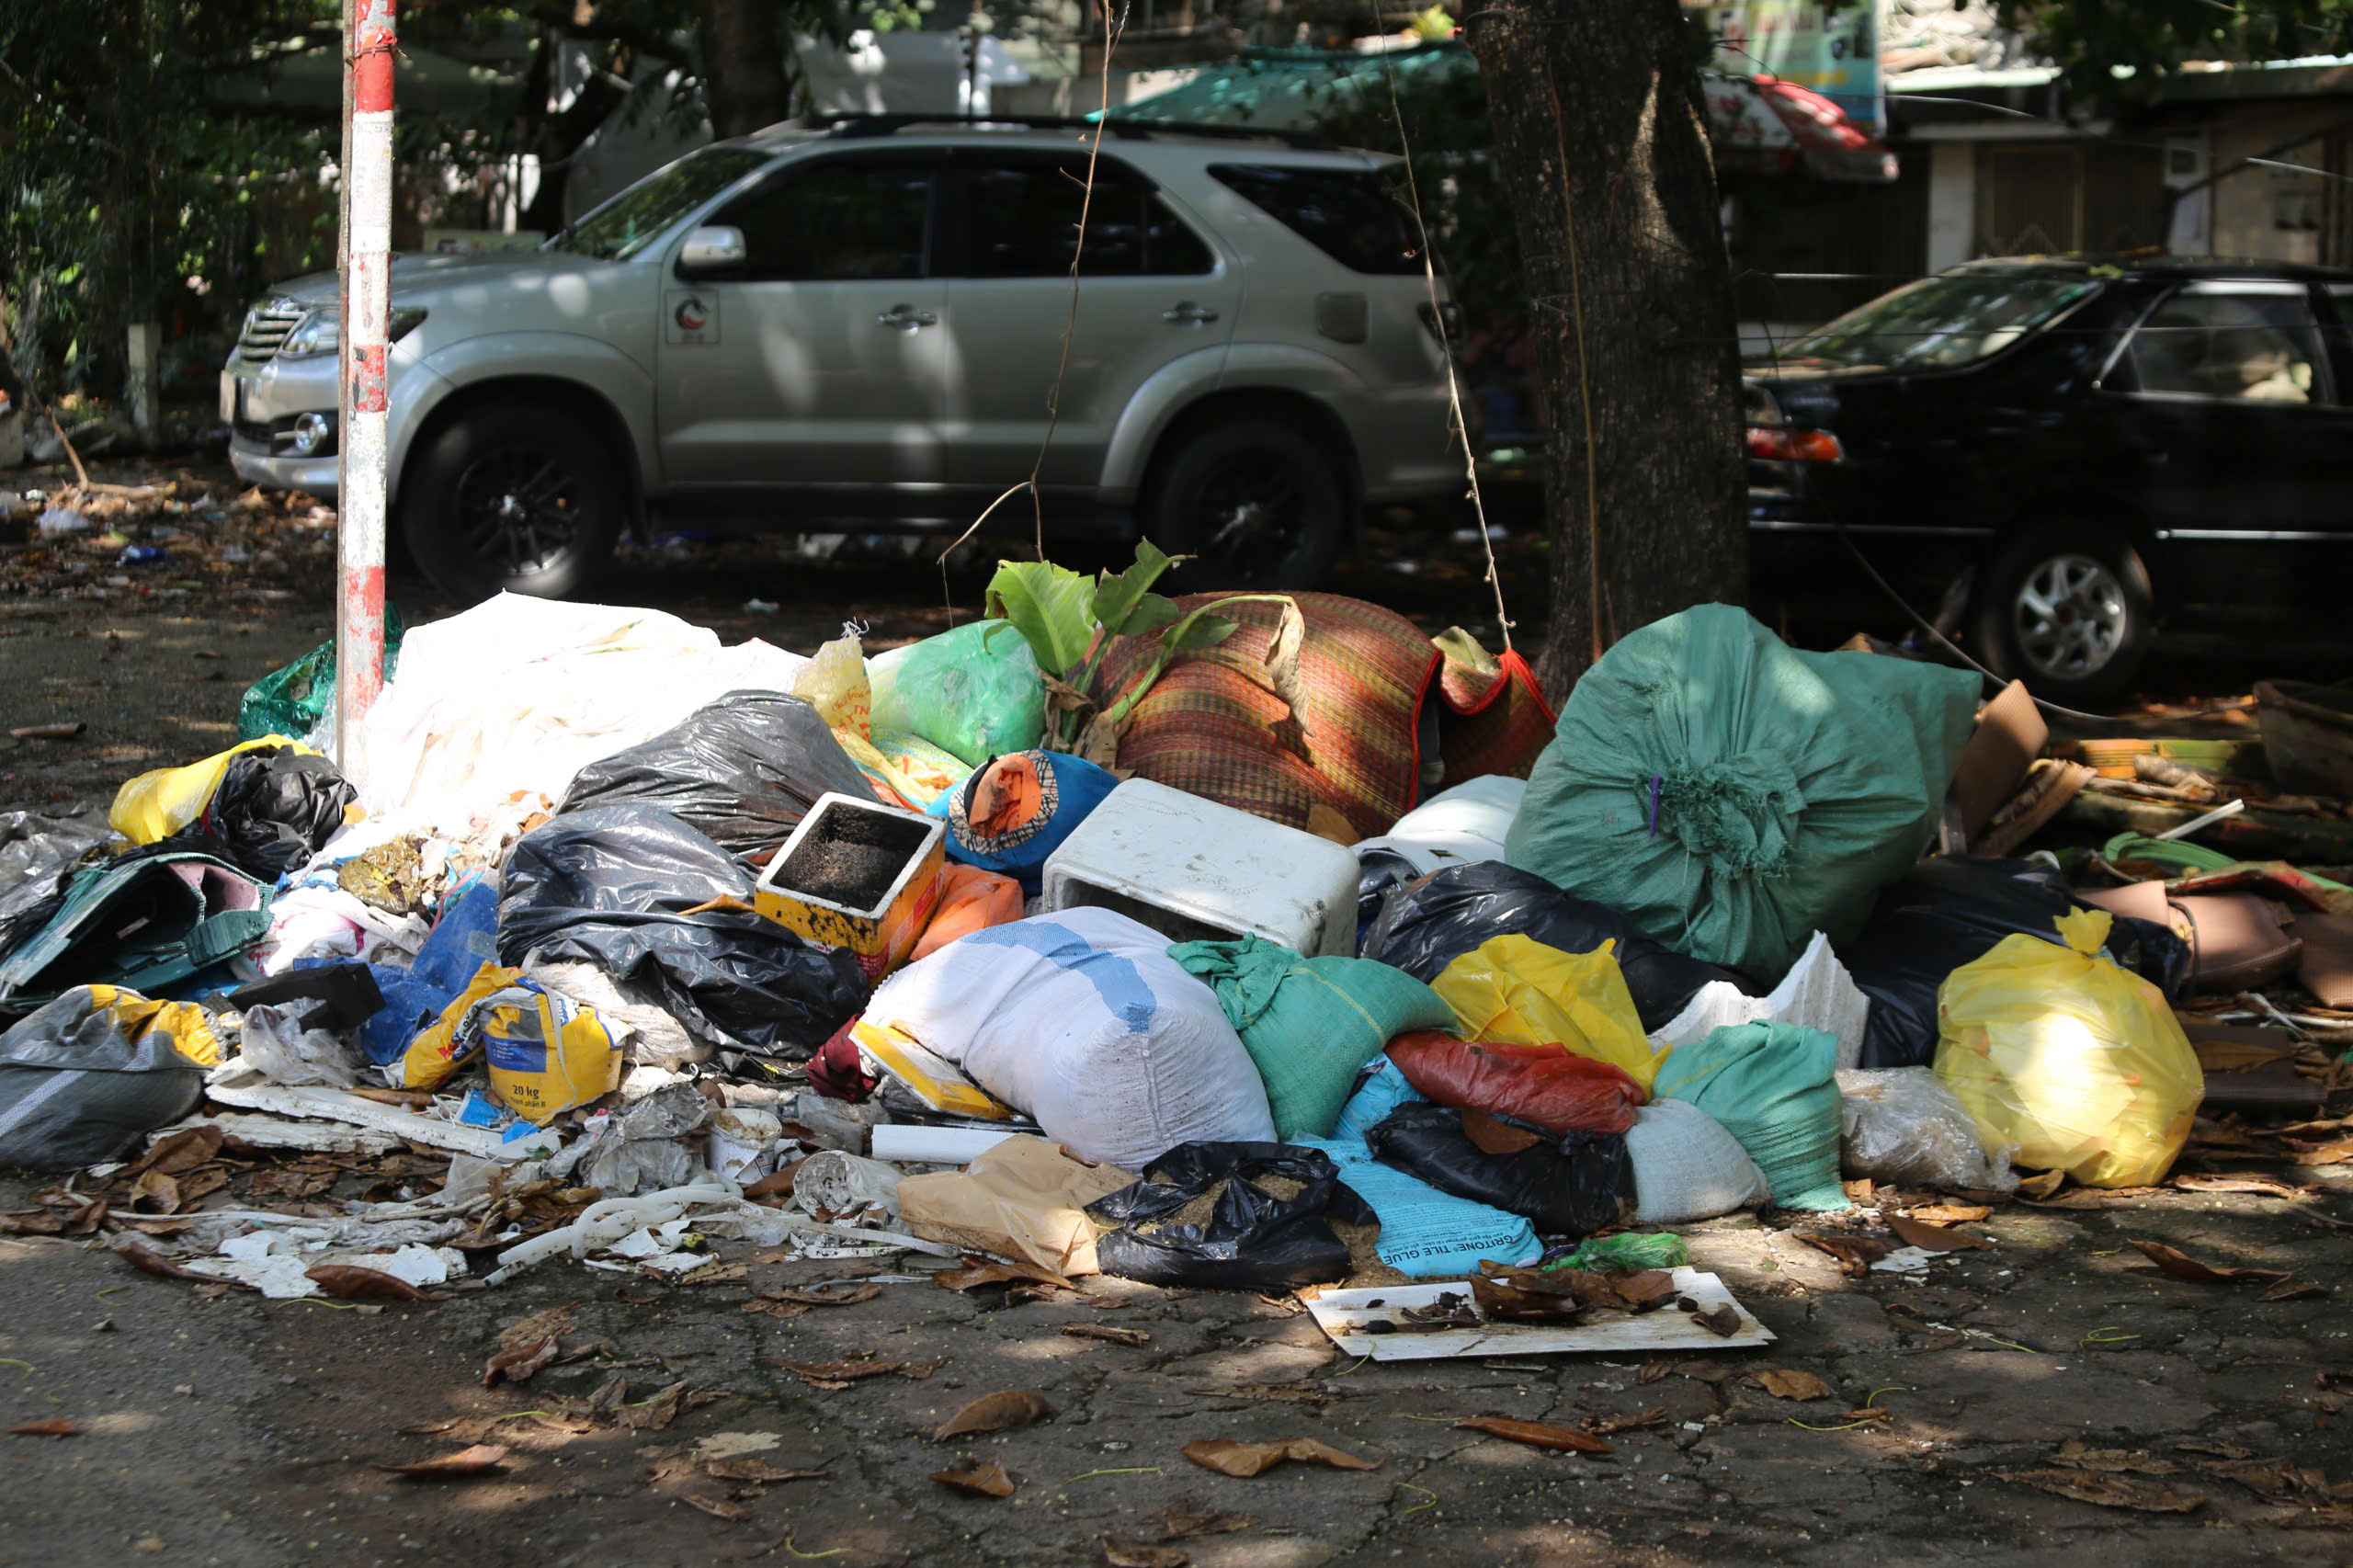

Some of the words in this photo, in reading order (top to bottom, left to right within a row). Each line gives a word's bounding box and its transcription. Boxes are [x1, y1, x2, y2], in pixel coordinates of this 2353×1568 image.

[513, 1085, 524, 1096] 20
[527, 1085, 540, 1099] kg
[1422, 1245, 1452, 1256] TILE
[1383, 1250, 1420, 1266] GLUE
